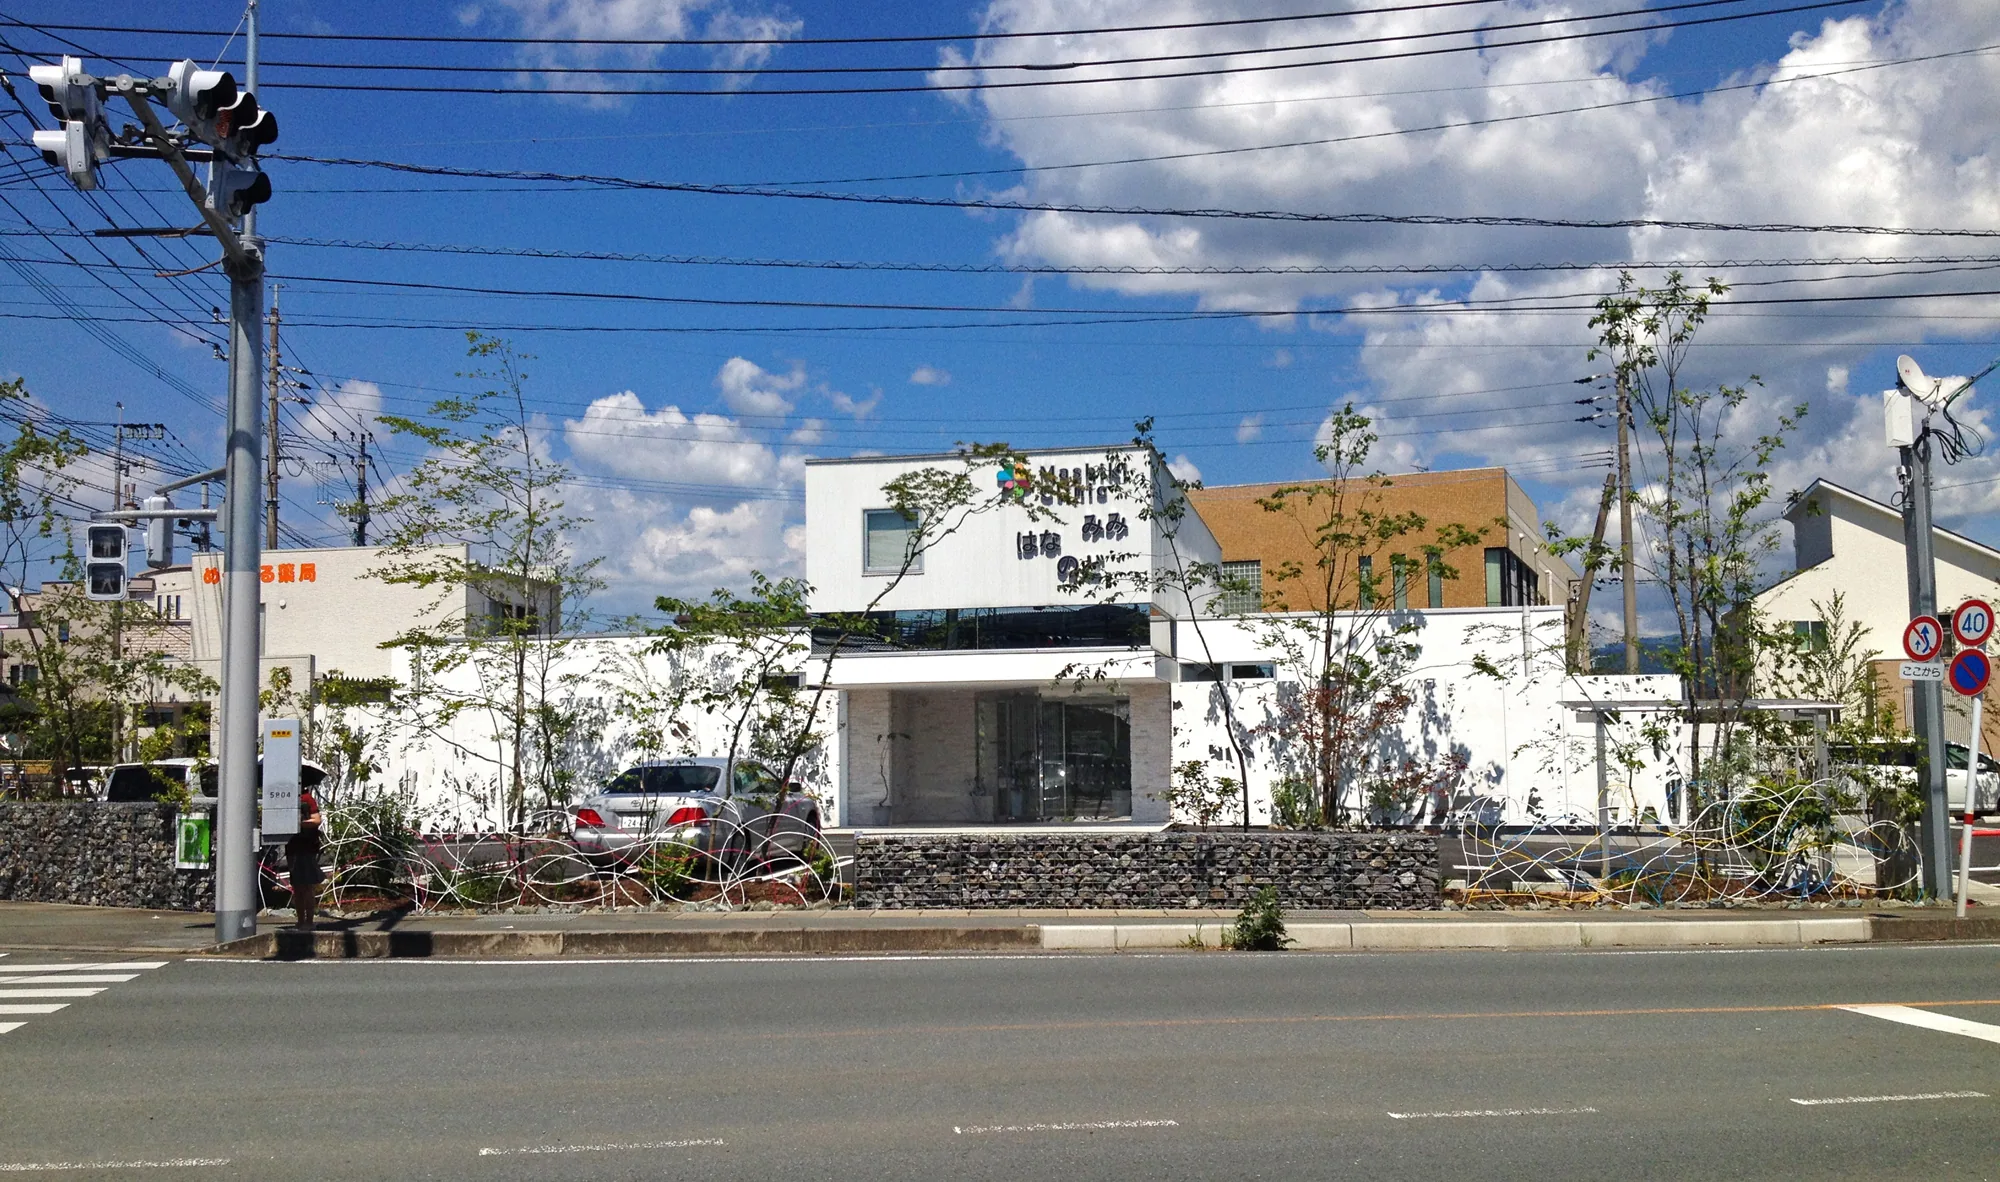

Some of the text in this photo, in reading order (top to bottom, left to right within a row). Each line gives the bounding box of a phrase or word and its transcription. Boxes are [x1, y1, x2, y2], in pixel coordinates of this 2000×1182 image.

[1082, 512, 1128, 536] みみ
[1017, 530, 1060, 553] はな
[203, 563, 316, 584] める薬局
[1962, 613, 1985, 633] 40
[1902, 666, 1941, 678] ここから
